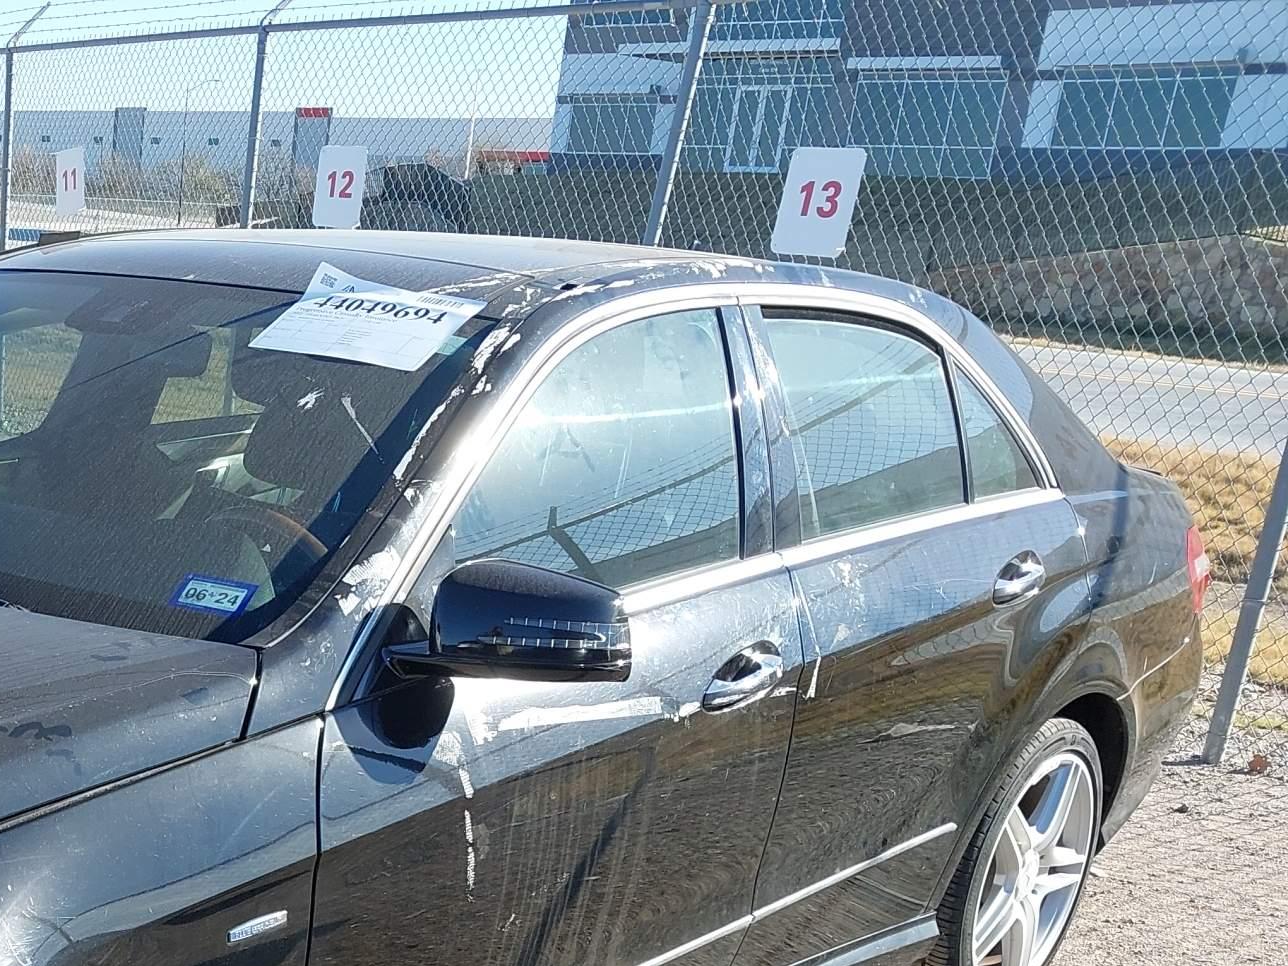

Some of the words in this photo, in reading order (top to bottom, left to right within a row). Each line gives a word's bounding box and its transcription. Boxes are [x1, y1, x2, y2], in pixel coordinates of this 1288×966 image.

[62, 167, 77, 192] 11
[327, 170, 355, 199] 12
[799, 180, 843, 219] 13
[314, 296, 448, 325] 44049694
[184, 587, 209, 601] 06
[214, 592, 240, 607] 24
